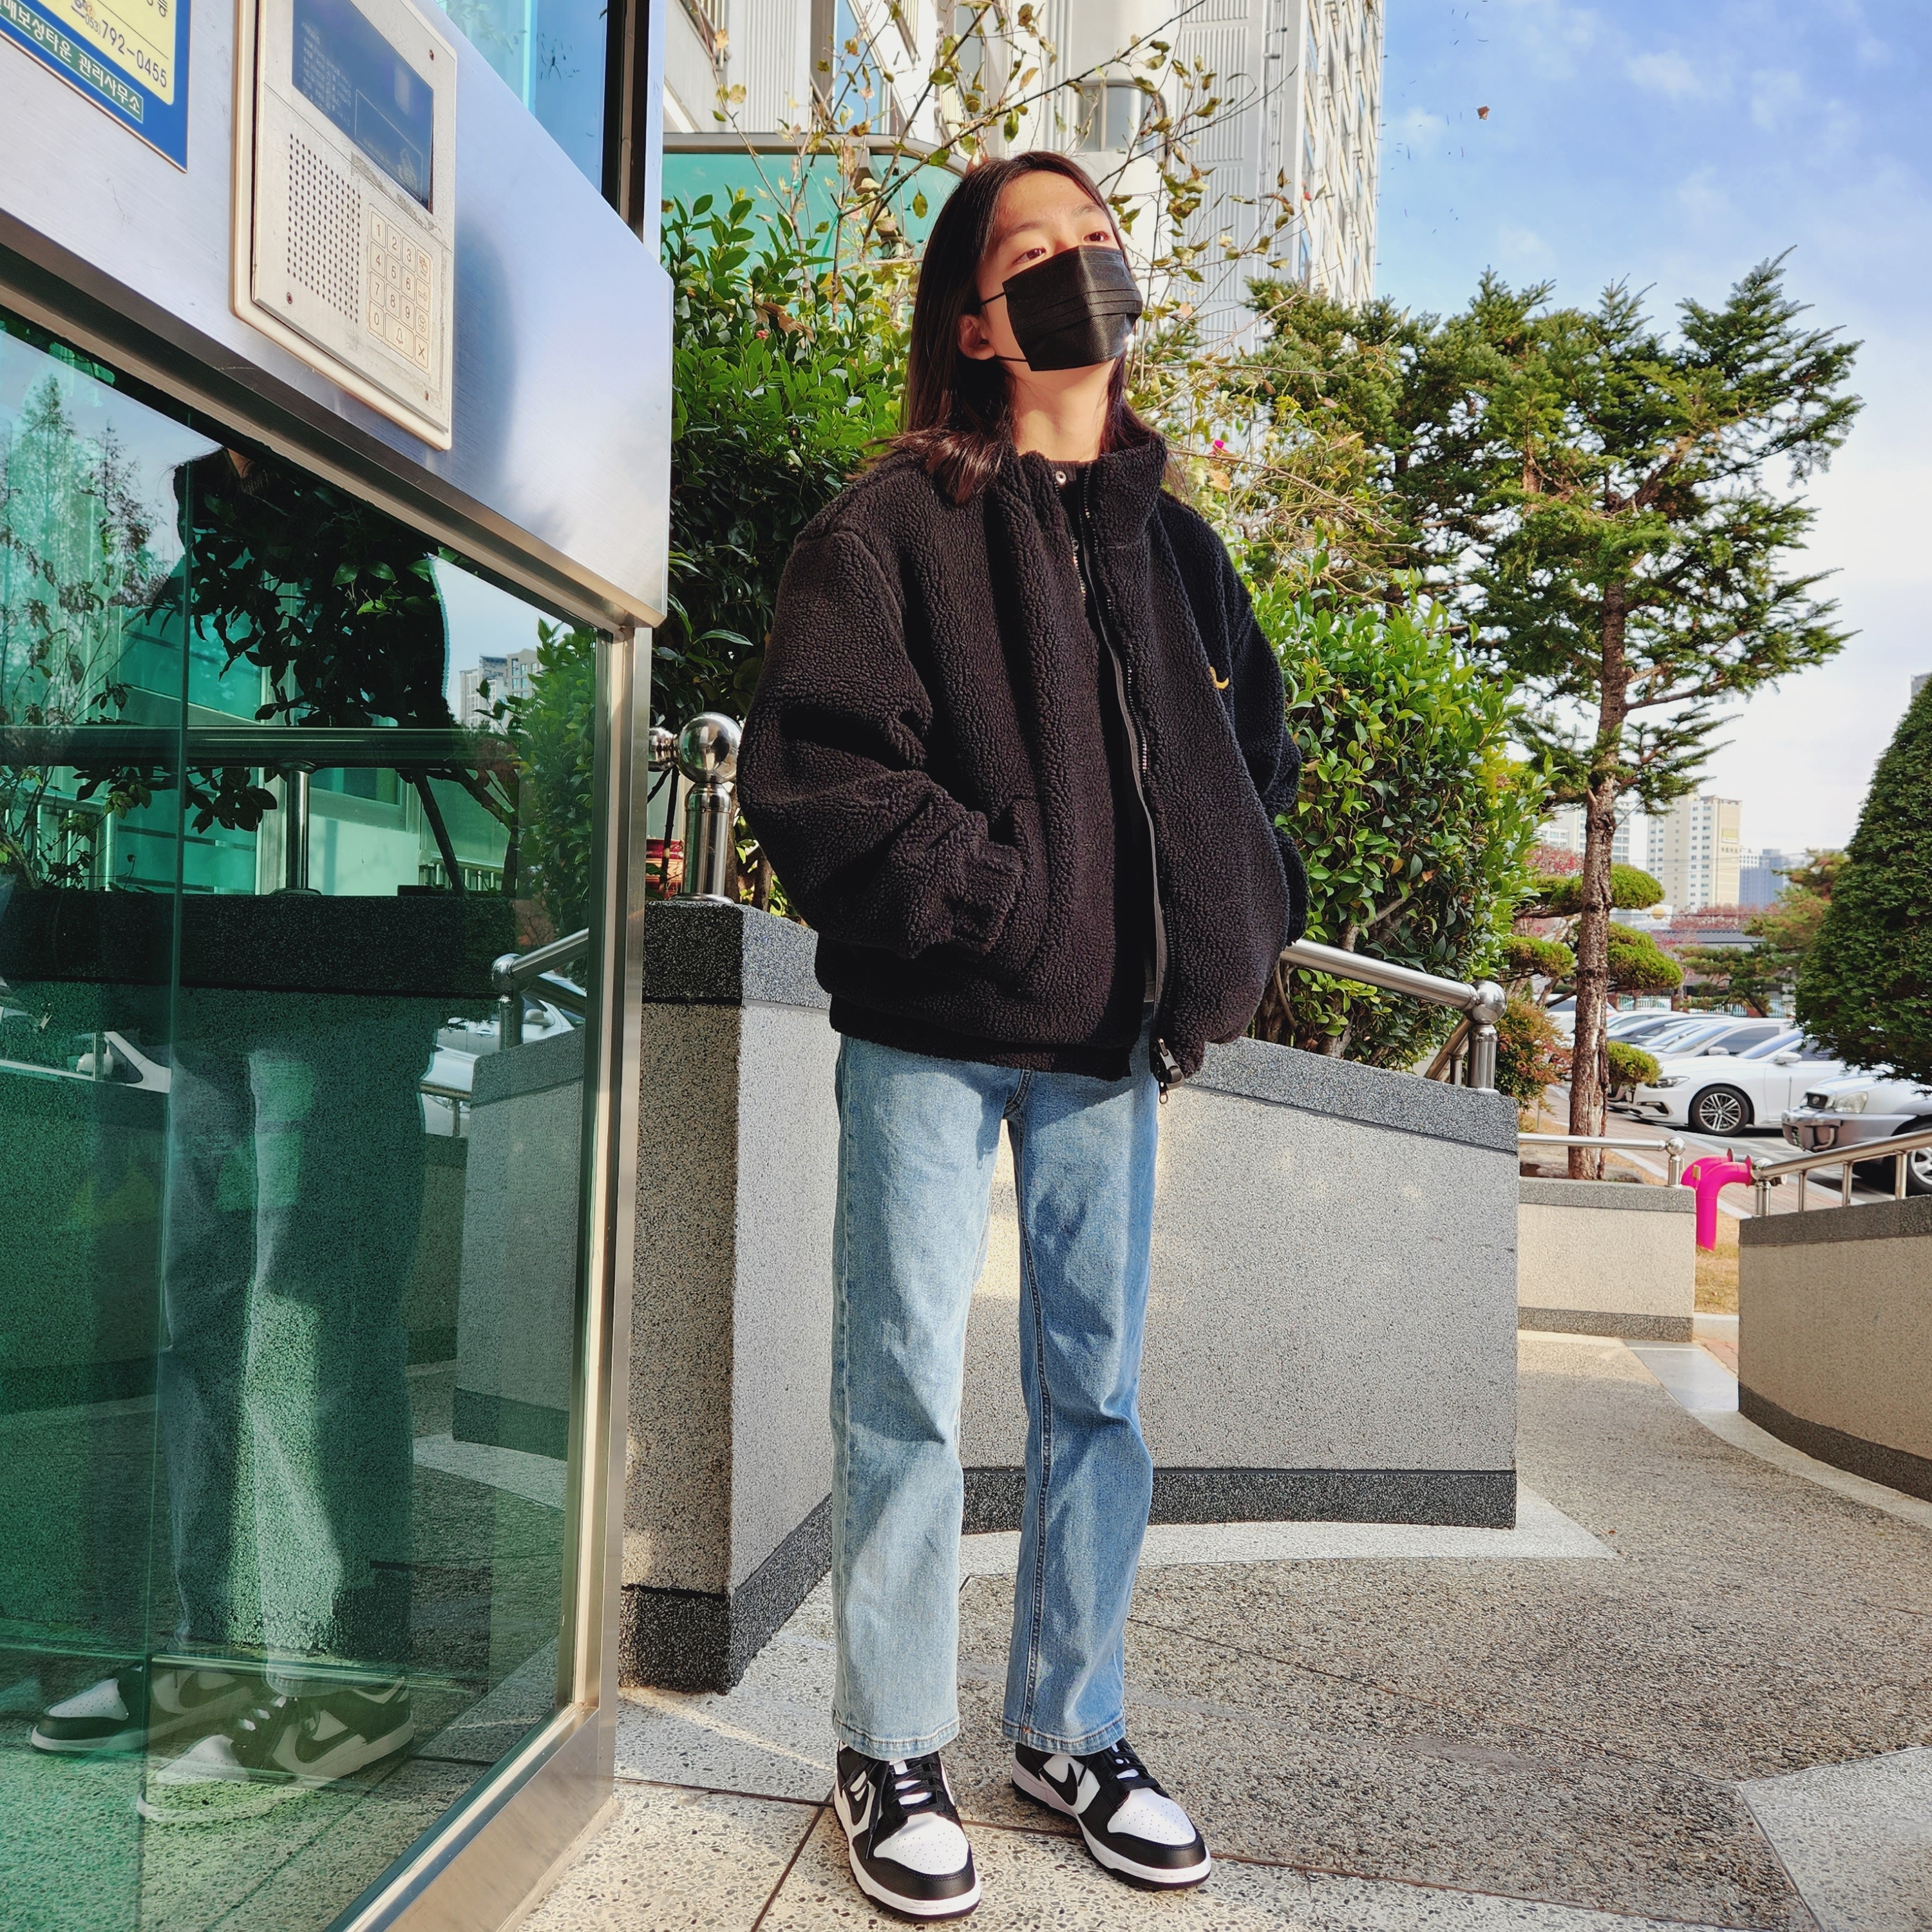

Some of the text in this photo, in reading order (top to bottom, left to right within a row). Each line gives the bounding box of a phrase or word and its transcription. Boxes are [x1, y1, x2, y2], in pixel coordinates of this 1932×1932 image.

[0, 0, 140, 115] 매보성타운 관리사무소
[376, 223, 412, 263] 1 2 3
[375, 254, 411, 290] 4 5 6
[374, 312, 379, 326] 0
[375, 281, 410, 319] 7 8 9
